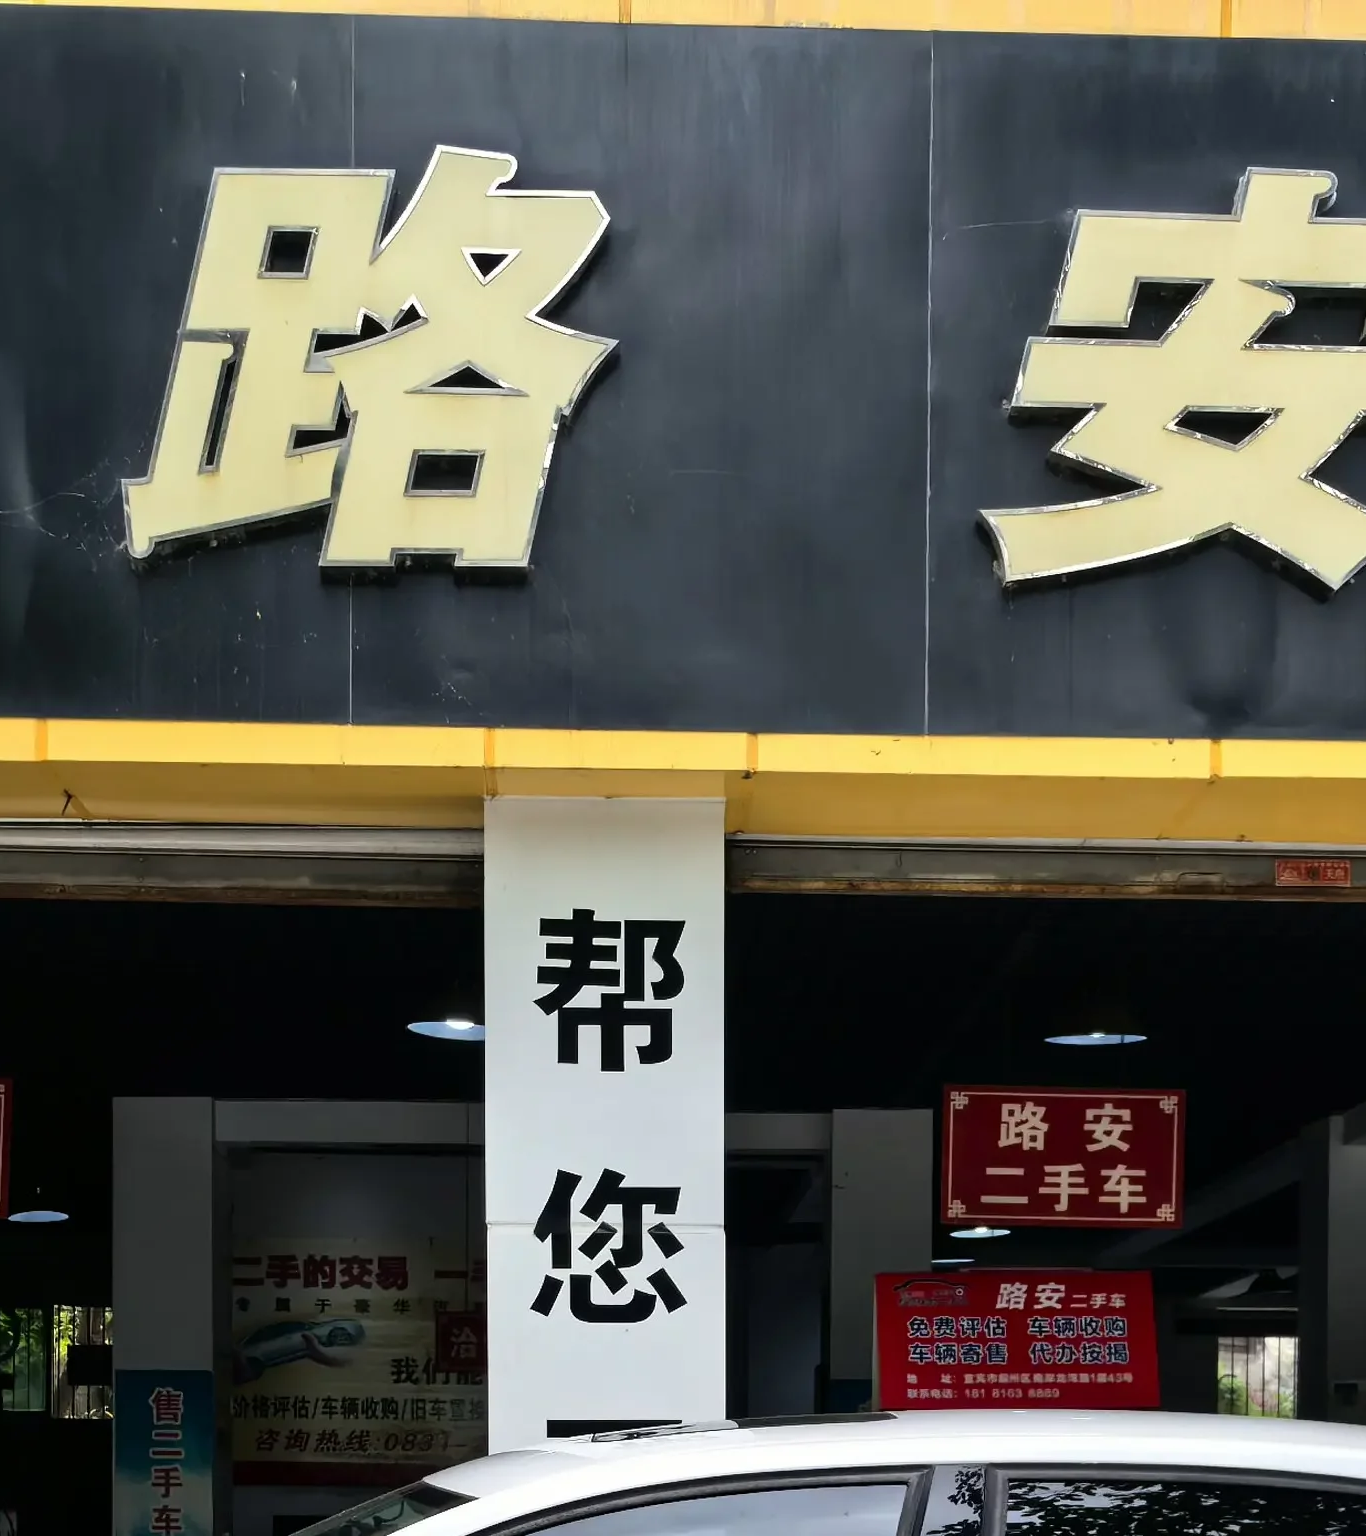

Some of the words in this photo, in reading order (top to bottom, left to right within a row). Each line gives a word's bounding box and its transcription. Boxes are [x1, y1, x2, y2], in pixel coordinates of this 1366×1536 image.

[998, 1101, 1133, 1152] 路安
[530, 908, 687, 1437] 帮您
[980, 1164, 1147, 1213] 二手车
[232, 1254, 409, 1290] 二手的交易
[907, 1315, 1007, 1338] 免费评估
[1027, 1316, 1127, 1339] 车辆收购
[908, 1342, 1008, 1365] 车辆寄售
[1029, 1342, 1129, 1366] 代办按揭
